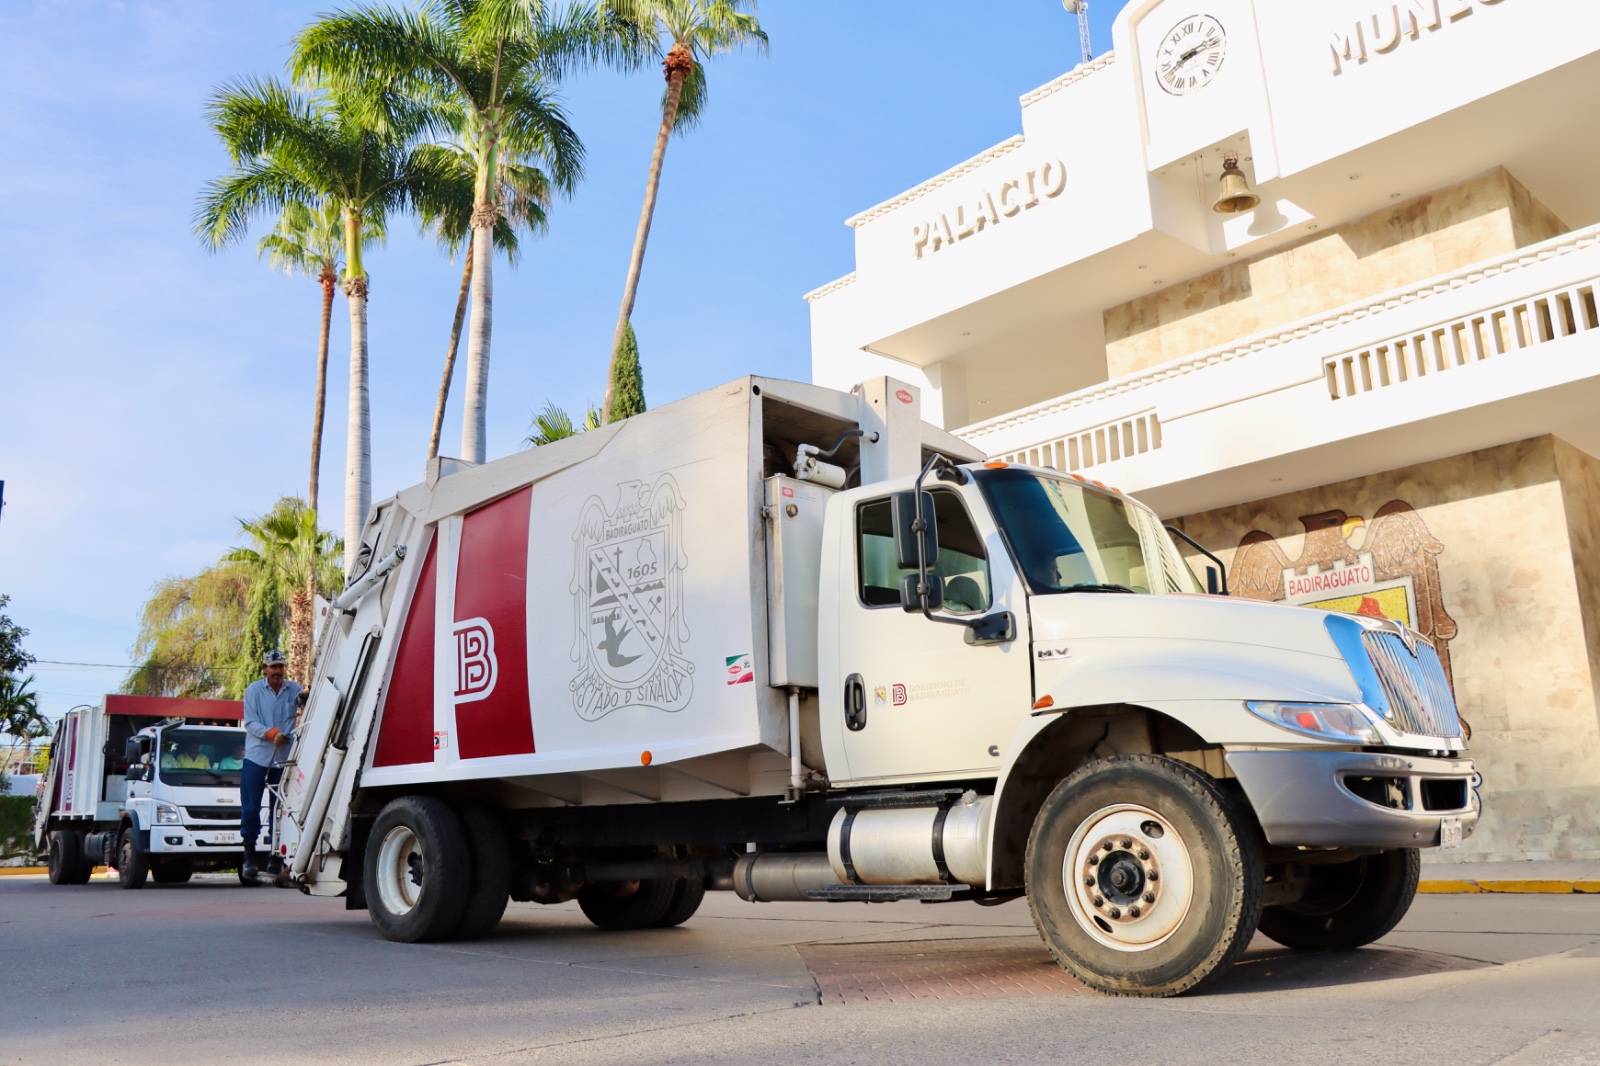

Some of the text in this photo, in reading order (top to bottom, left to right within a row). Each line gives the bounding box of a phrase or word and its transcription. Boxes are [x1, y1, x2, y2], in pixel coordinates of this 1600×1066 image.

[1181, 22, 1194, 37] XII
[1328, 0, 1506, 77] MUN
[911, 158, 1067, 260] PALACIO
[605, 519, 649, 541] BADIRAGUATO
[627, 562, 658, 580] 1605
[1288, 566, 1370, 596] BADIRAGUATO
[637, 669, 688, 703] SINALOA
[908, 678, 967, 692] GOBIERNO DE
[909, 686, 971, 701] BADIRAGUATO
